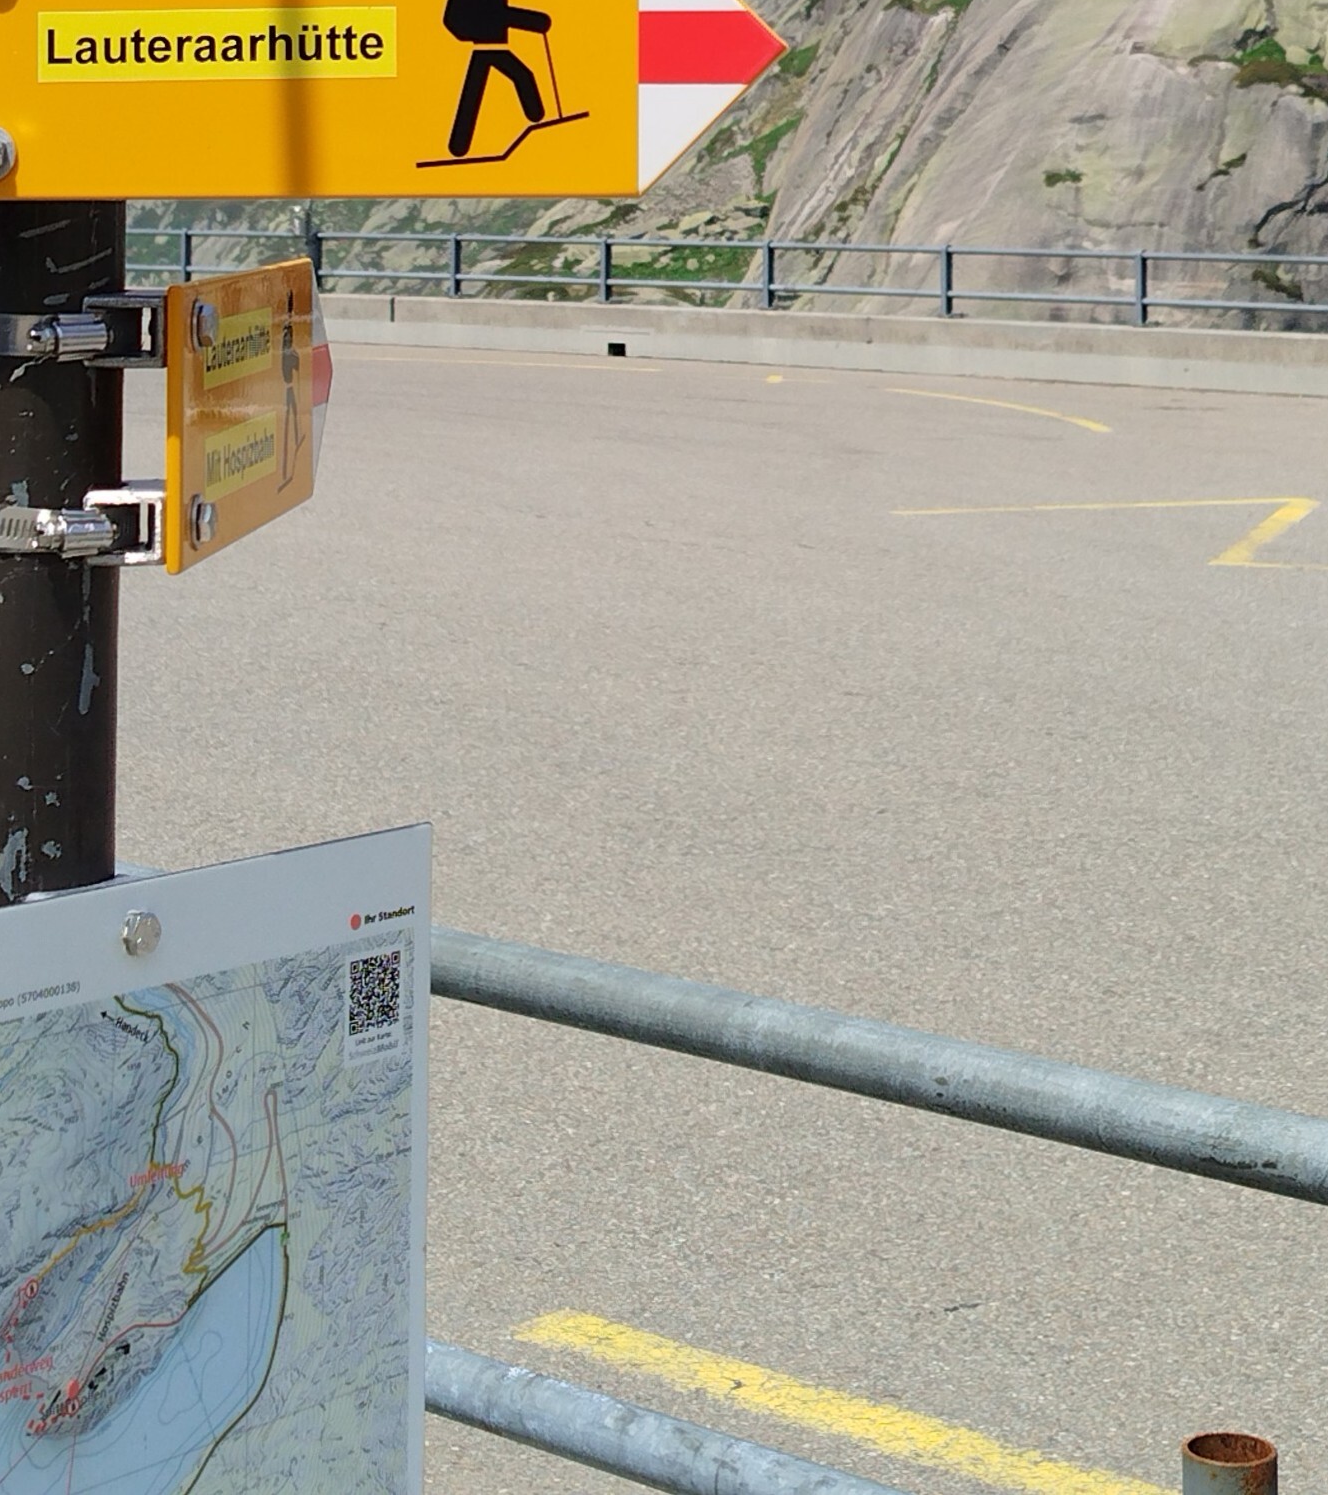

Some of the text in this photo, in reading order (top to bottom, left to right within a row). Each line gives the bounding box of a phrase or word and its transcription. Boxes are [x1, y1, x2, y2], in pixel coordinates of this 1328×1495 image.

[47, 25, 384, 65] Lauteraarhütte
[378, 905, 415, 922] Standort
[97, 1271, 130, 1343] Hospizbahn
